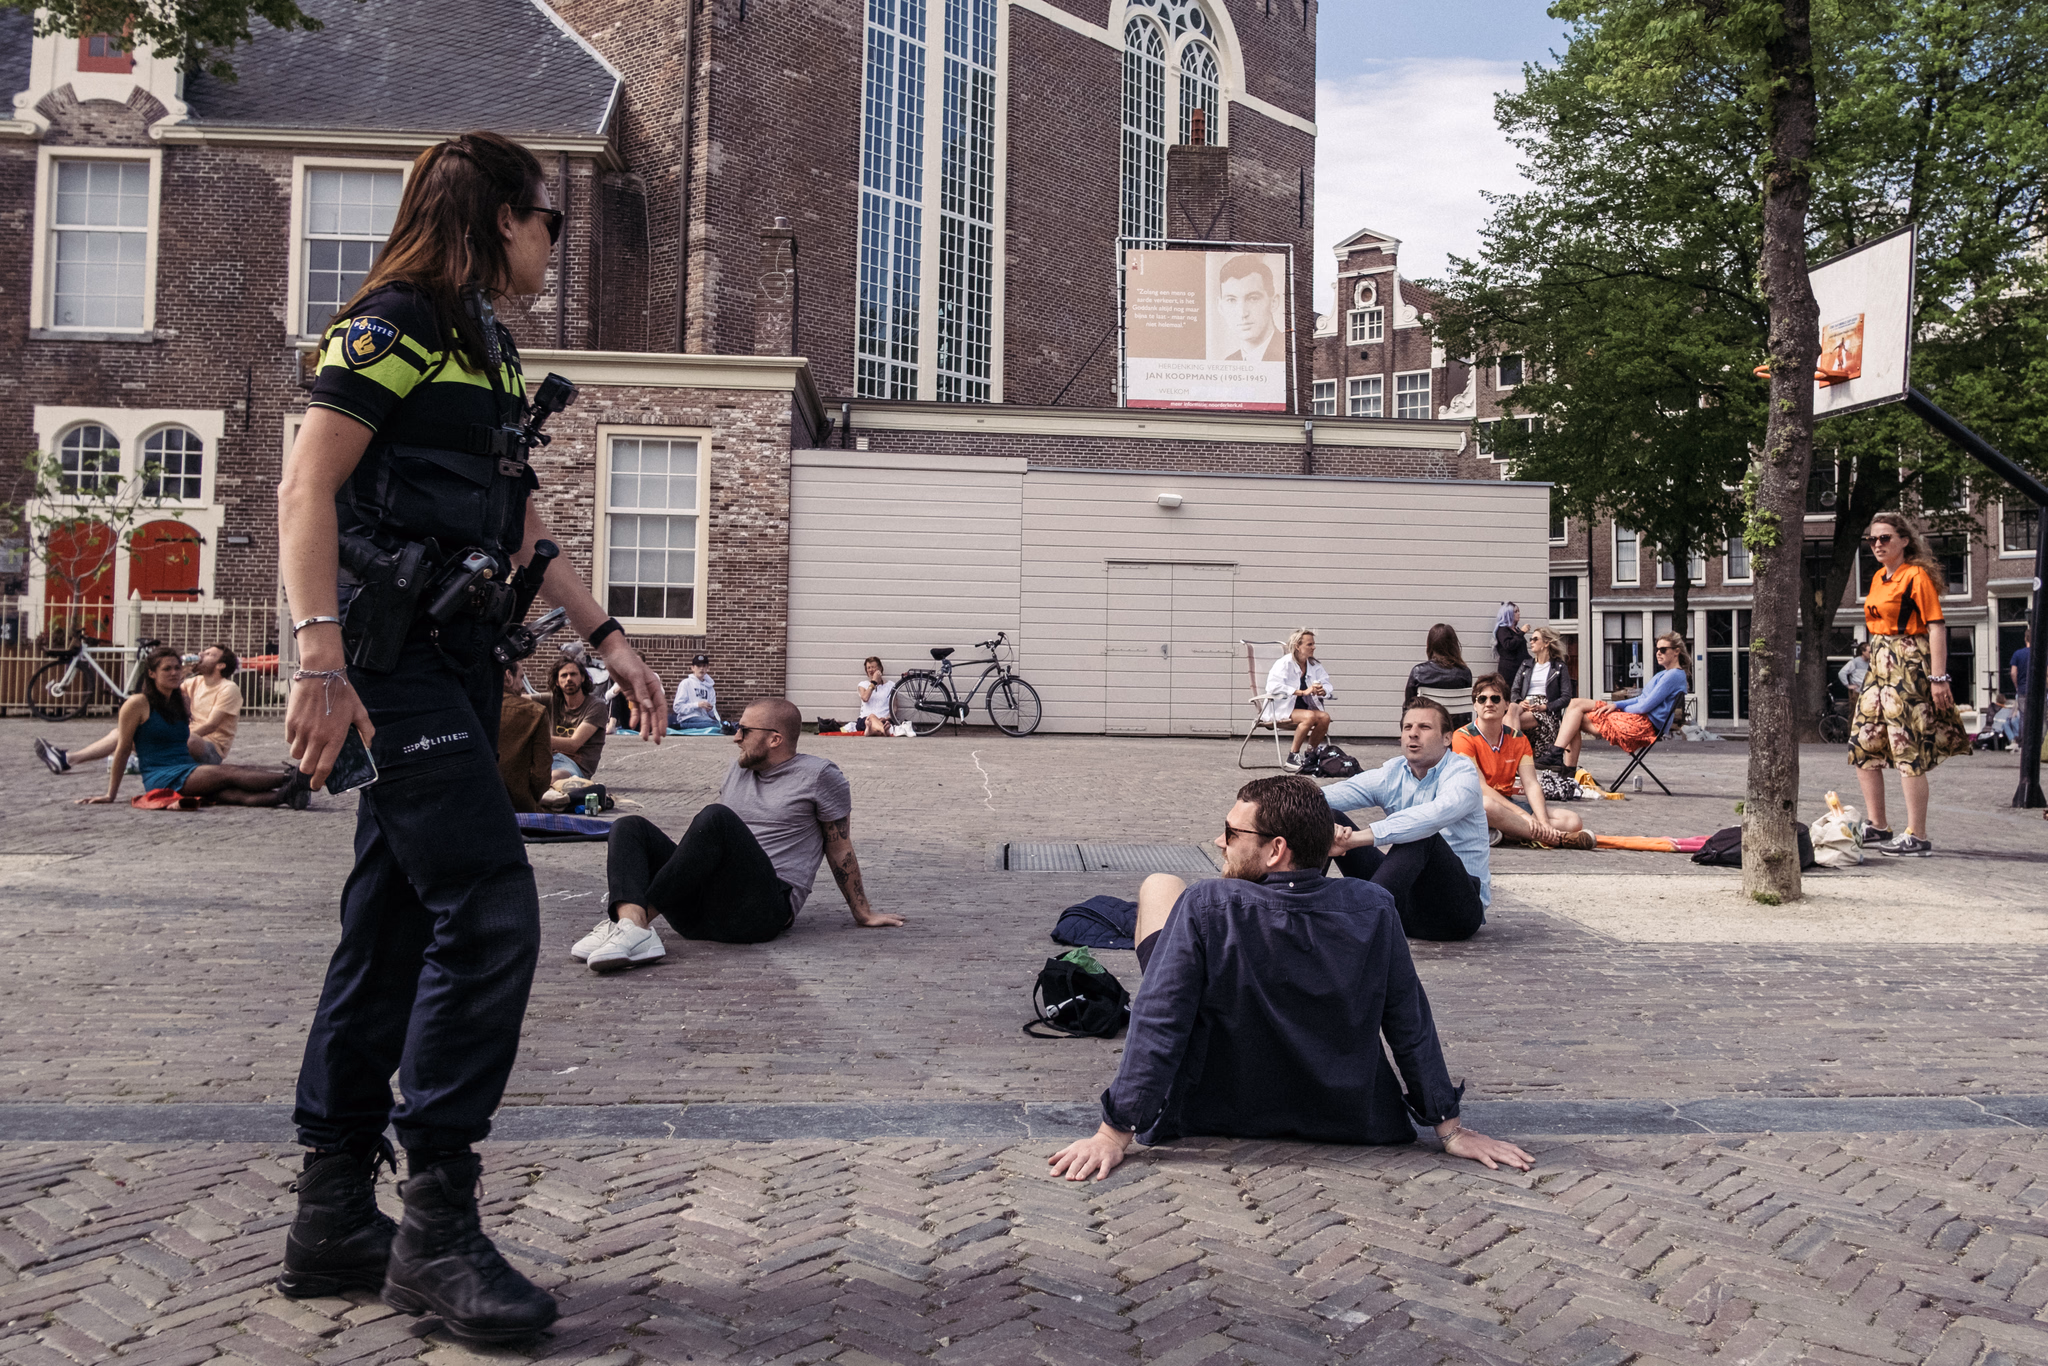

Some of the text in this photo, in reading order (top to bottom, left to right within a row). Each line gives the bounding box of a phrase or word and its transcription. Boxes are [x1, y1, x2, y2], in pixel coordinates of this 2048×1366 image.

[1158, 305, 1173, 313] altijd
[1134, 312, 1148, 320] bijna
[354, 321, 394, 338] POLITIE
[1158, 362, 1255, 372] HERDENKING VERZETSHELD
[1145, 372, 1268, 383] JAN KOOPMANS (1905-1945)
[1867, 605, 1882, 619] 10
[414, 733, 458, 750] POLITIE
